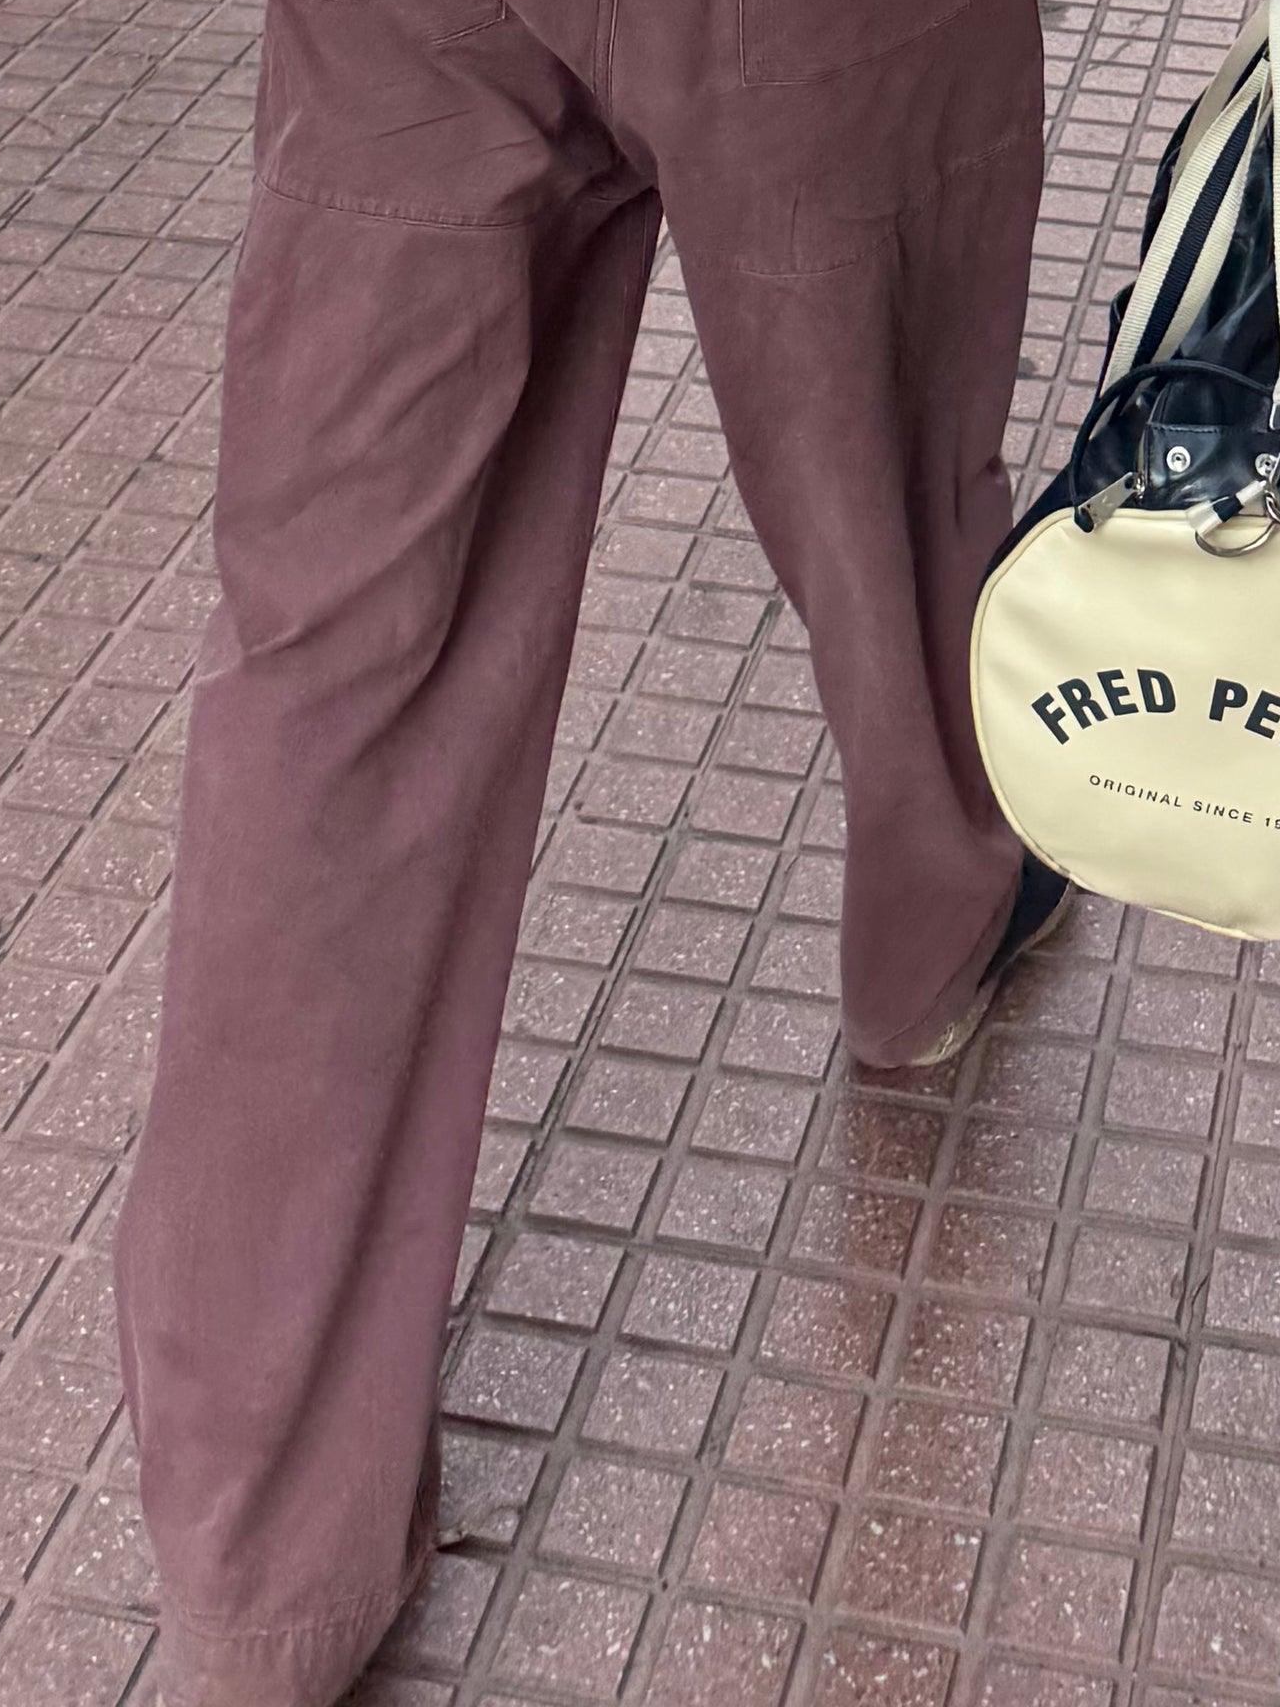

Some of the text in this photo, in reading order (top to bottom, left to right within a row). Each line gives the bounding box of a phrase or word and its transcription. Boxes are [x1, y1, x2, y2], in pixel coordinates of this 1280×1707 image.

[1031, 668, 1177, 745] FRED
[1089, 774, 1182, 808] ORIGINAL
[1192, 799, 1254, 824] SINCE
